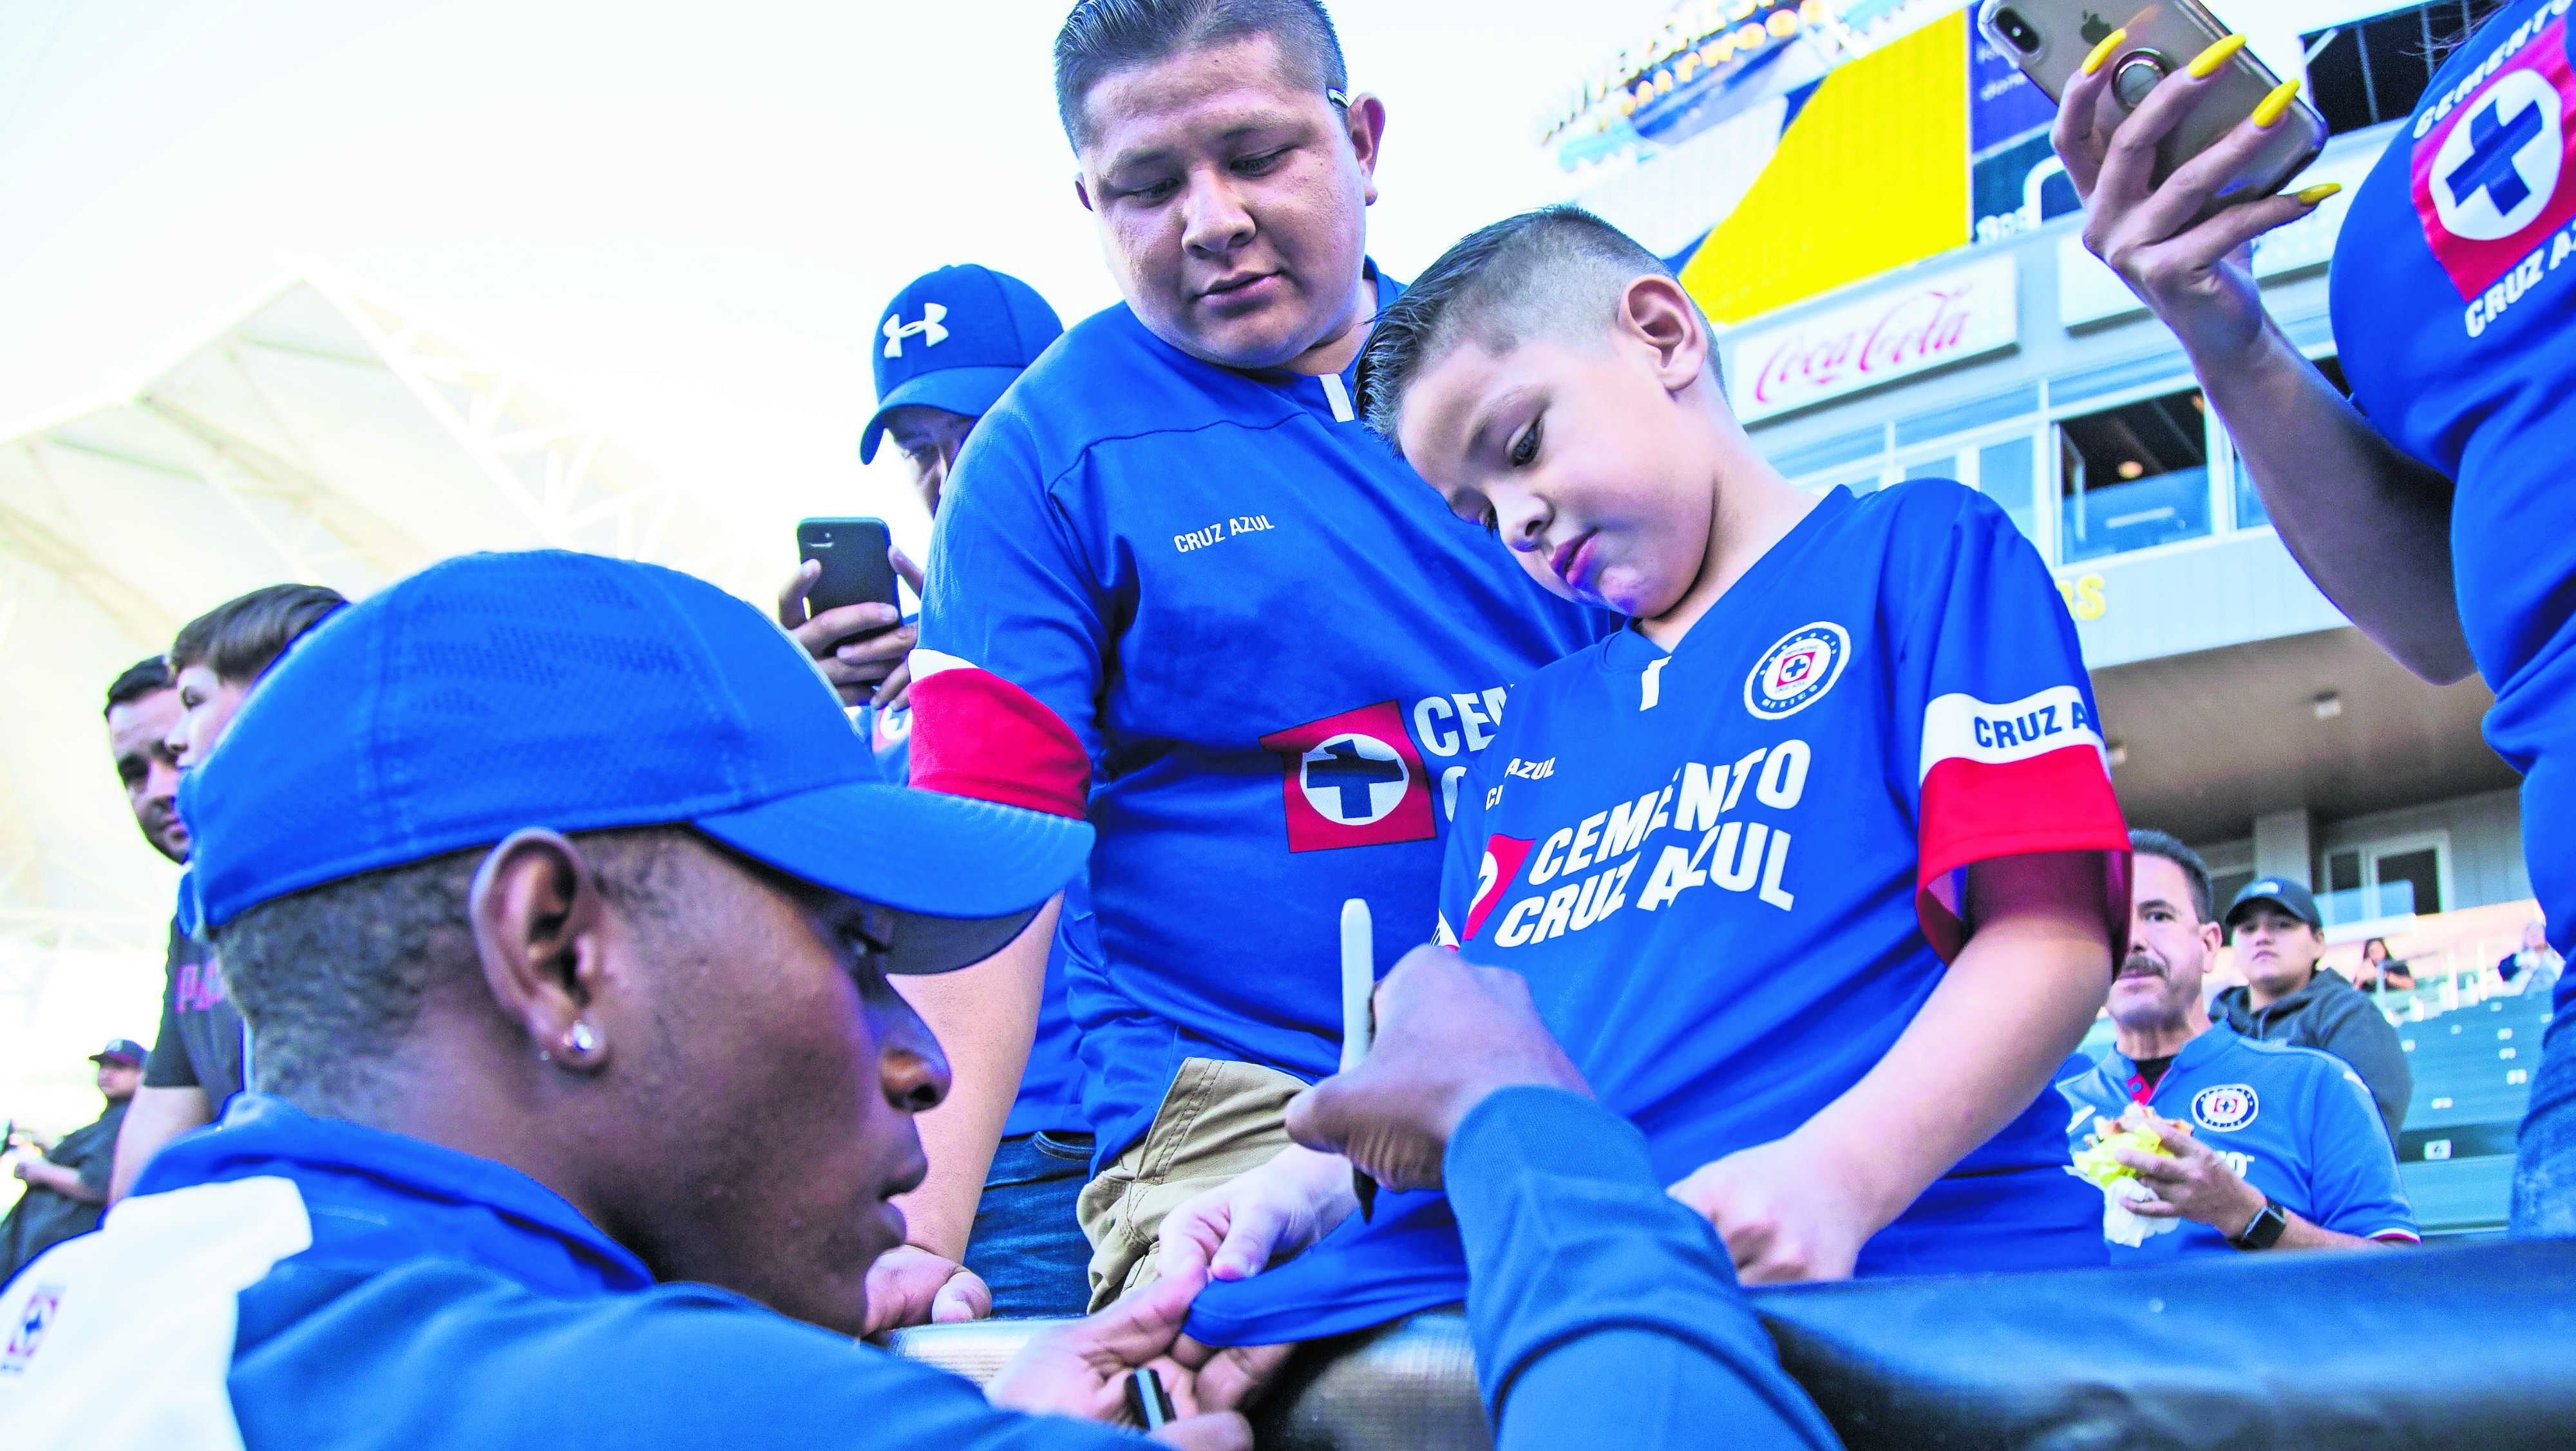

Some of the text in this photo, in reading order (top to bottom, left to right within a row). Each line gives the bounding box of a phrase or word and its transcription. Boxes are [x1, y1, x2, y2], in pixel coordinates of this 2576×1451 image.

[2465, 249, 2544, 337] CRUZ
[1174, 515, 1274, 553] CRUZ AZUL
[1975, 705, 2063, 748] CRUZ
[1504, 757, 1556, 780] AZUL
[1494, 821, 1794, 947] CRUZ AZUL
